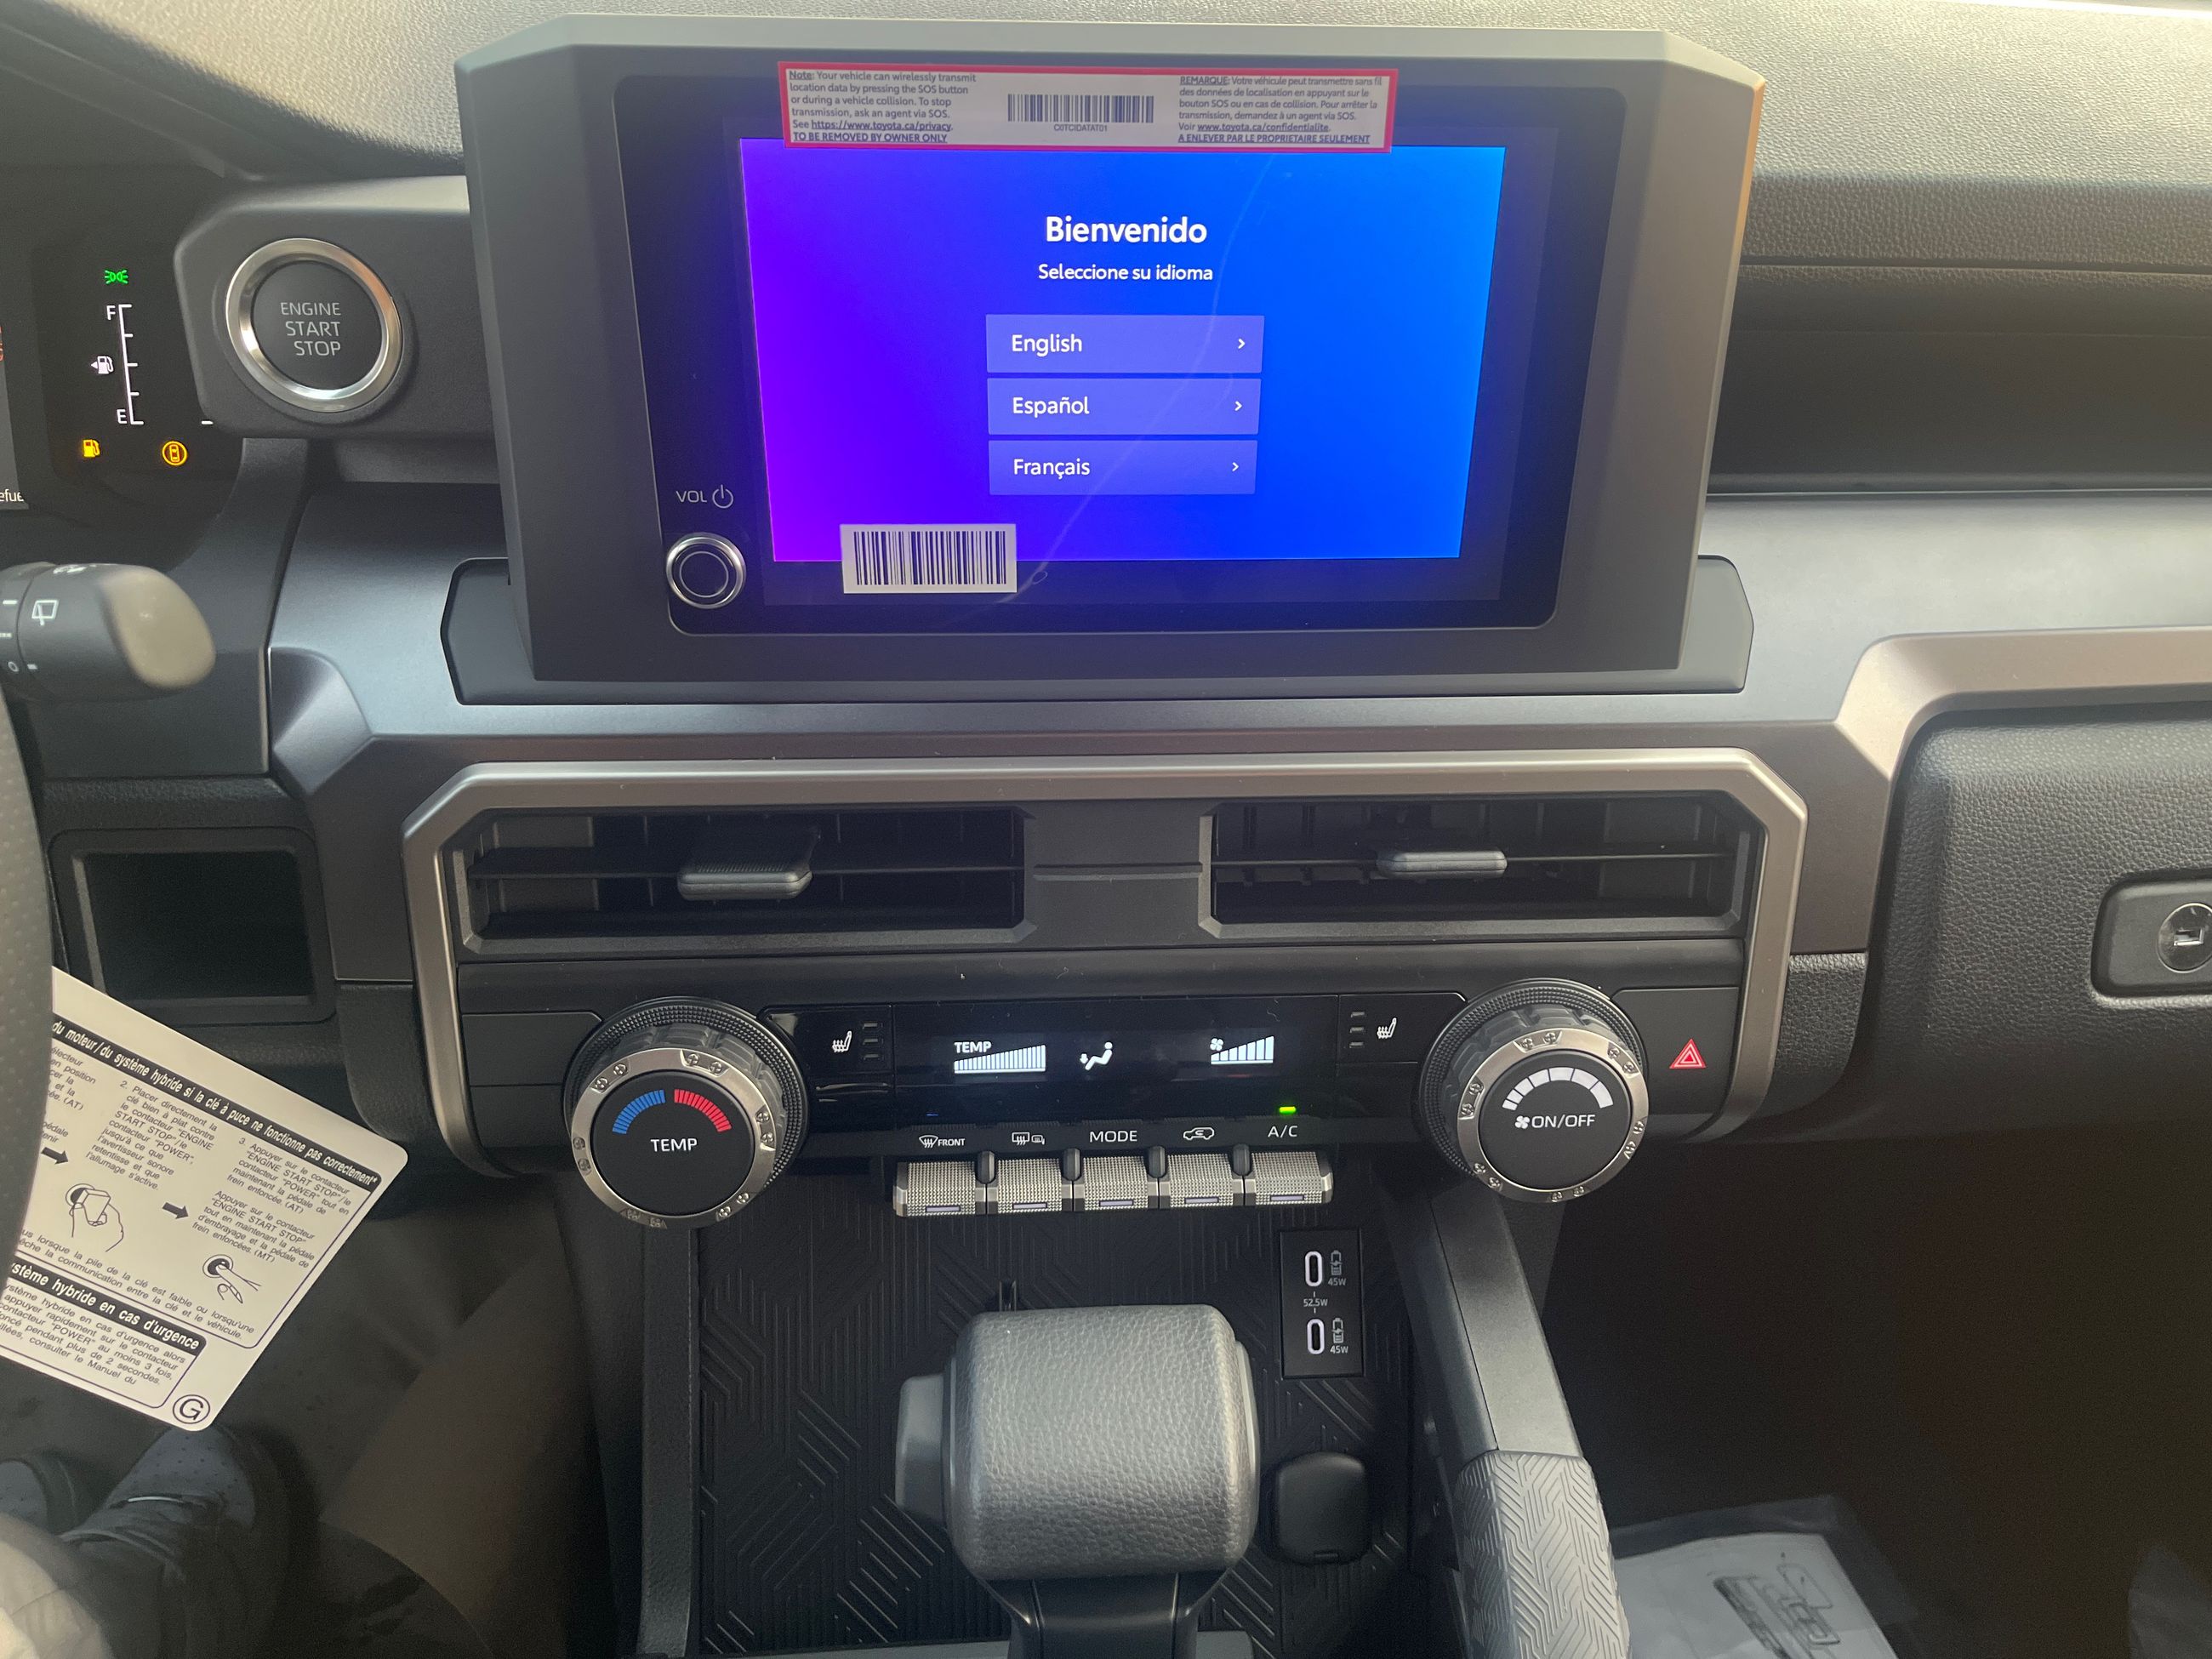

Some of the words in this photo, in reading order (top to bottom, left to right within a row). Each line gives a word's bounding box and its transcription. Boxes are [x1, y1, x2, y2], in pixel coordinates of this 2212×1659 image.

[789, 71, 815, 81] Note:
[817, 71, 838, 80] Your
[839, 71, 873, 81] vehicle
[892, 72, 936, 83] wirelessly
[938, 73, 976, 83] transmit
[1232, 77, 1252, 85] Votre
[1288, 78, 1307, 87] peut
[790, 83, 825, 92] location
[828, 83, 847, 92] data
[849, 84, 859, 94] by
[862, 84, 899, 94] pressing
[902, 85, 916, 94] the
[918, 85, 937, 94] SOS
[938, 85, 968, 94] button
[1179, 88, 1194, 96] des
[1196, 88, 1232, 96] données
[1234, 88, 1244, 97] de
[1246, 88, 1292, 97] localisation
[1307, 89, 1346, 99] appuyant
[802, 95, 833, 106] during
[841, 96, 875, 105] vehicle
[876, 97, 917, 105] collision.
[919, 97, 929, 105] To
[931, 99, 951, 107] stop
[1179, 100, 1210, 108] bouton
[1211, 100, 1229, 108] SOS
[1282, 100, 1318, 109] collision.
[1320, 100, 1339, 109] Pour
[791, 108, 852, 118] transmission,
[854, 109, 869, 117] ask
[885, 110, 912, 119] agent
[914, 110, 926, 118] via
[928, 109, 949, 118] SOS.
[1179, 111, 1233, 121] transmission,
[1234, 111, 1278, 120] demandez
[1298, 113, 1322, 122] agent
[1337, 112, 1356, 121] SOS.
[1178, 123, 1197, 131] Voir
[793, 133, 807, 142] TO
[808, 133, 820, 142] BE
[822, 133, 868, 143] REMOVED
[870, 134, 882, 143] BY
[884, 134, 921, 143] OWNER
[922, 134, 948, 143] ONLY
[1186, 134, 1224, 144] ENLEVER
[1226, 134, 1243, 144] PAR
[1245, 134, 1257, 144] LE
[1258, 134, 1318, 144] PROPRIETAIRE
[1319, 135, 1371, 145] SEULEMENT
[1046, 215, 1207, 244] Bienvenido
[1038, 264, 1129, 281] Seleccione
[1132, 267, 1151, 281] su
[1155, 264, 1213, 281] idioma
[106, 305, 116, 320] F
[281, 302, 342, 316] ENGINE
[285, 321, 341, 336] START
[294, 341, 341, 356] STOP
[1012, 334, 1083, 357] English
[1012, 396, 1090, 419] Español
[117, 409, 127, 425] E
[1012, 458, 1091, 480] Français
[676, 490, 707, 504] VOL
[954, 1041, 992, 1054] TEMP
[52, 1021, 65, 1034] du
[114, 1053, 149, 1075] système
[150, 1069, 182, 1092] hybride
[183, 1087, 195, 1097] si
[194, 1091, 203, 1103] la
[205, 1097, 221, 1109] clé
[219, 1103, 228, 1114] à
[226, 1109, 249, 1125] puce
[250, 1120, 263, 1131] ne
[264, 1125, 305, 1152] fonctionne
[305, 1148, 322, 1160] pas
[132, 1086, 158, 1102] Placer
[161, 1101, 207, 1126] directement
[115, 1110, 145, 1127] START
[126, 1095, 139, 1103] clé
[141, 1101, 159, 1114] bien
[170, 1117, 187, 1127] plat
[190, 1126, 214, 1140] contre
[132, 1109, 173, 1131] contacteur
[1531, 1113, 1596, 1130] ON/OFF
[1089, 1130, 1138, 1143] MODE
[1268, 1125, 1298, 1139] A/C
[650, 1137, 698, 1152] TEMP
[937, 1137, 966, 1147] FRONT
[249, 1143, 282, 1161] Appuyer
[284, 1160, 298, 1169] sur
[311, 1173, 350, 1194] contacteur
[238, 1160, 278, 1180] contacteur
[321, 1198, 336, 1208] tout
[282, 1169, 311, 1185] START
[226, 1174, 244, 1186] frein
[247, 1185, 282, 1205] enfoncée.
[284, 1201, 303, 1213] (AT)
[232, 1167, 275, 1189] maintenant
[286, 1194, 312, 1208] pédale
[12, 1264, 48, 1285] stème
[51, 1279, 95, 1305] hybride
[100, 1302, 115, 1314] en
[118, 1310, 140, 1324] cas
[143, 1320, 198, 1348] d'urgence
[1303, 1298, 1328, 1307] 52.5W
[1330, 1345, 1348, 1354] 45W
